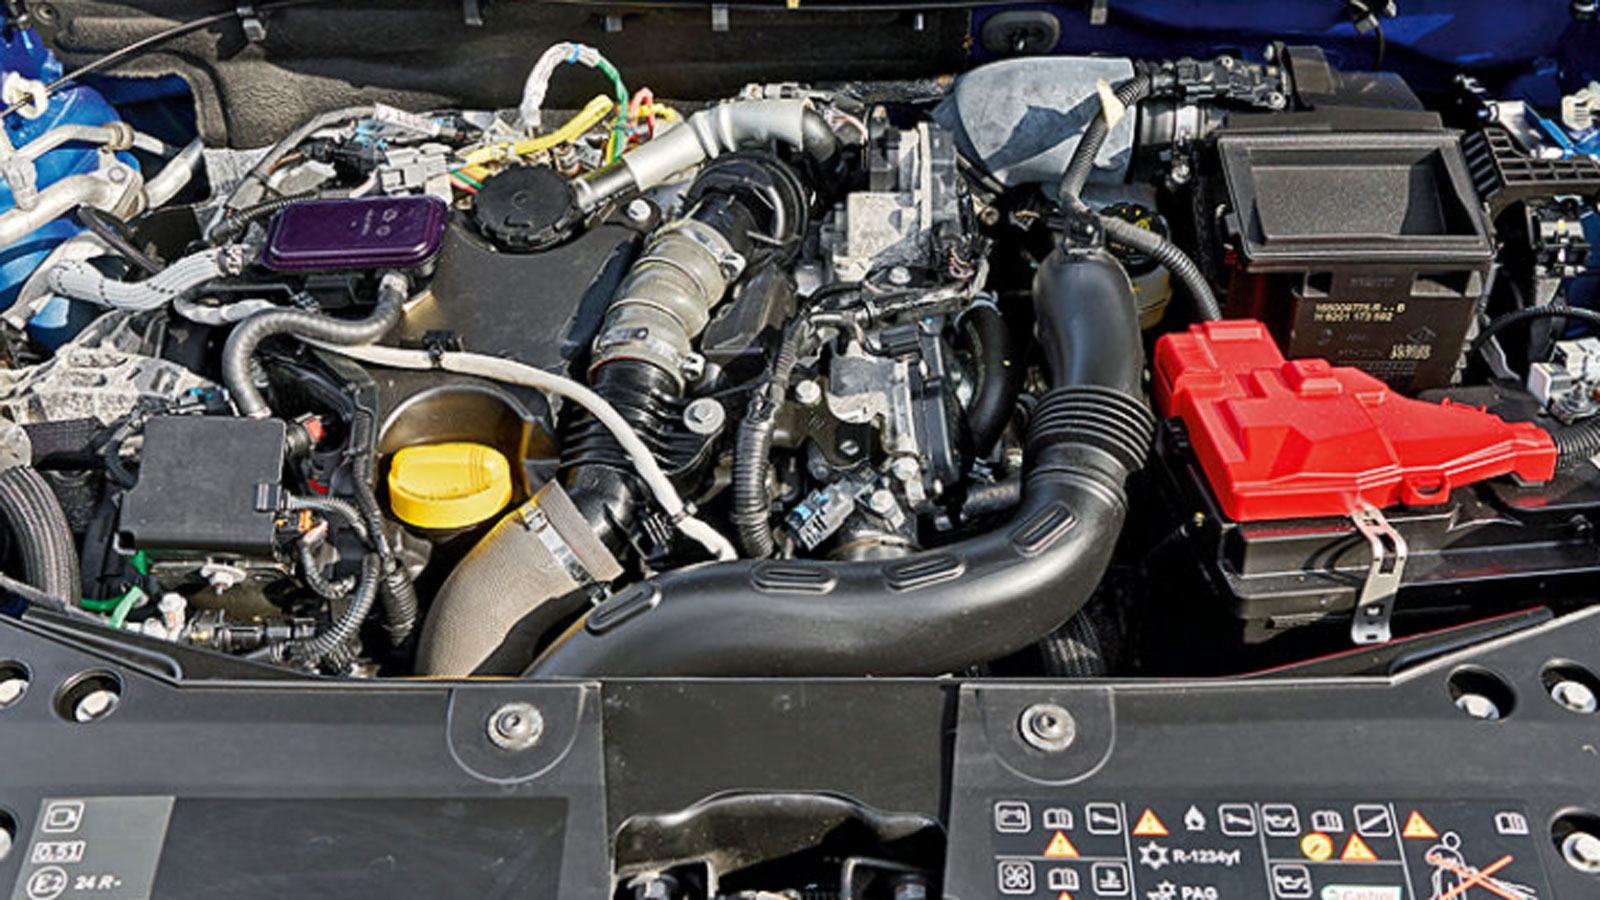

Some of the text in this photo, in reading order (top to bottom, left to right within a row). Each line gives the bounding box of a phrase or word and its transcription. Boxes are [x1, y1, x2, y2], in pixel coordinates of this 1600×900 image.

[1172, 848, 1240, 867] R-1234yf
[74, 875, 97, 890] 24
[1181, 886, 1219, 900] PAG
